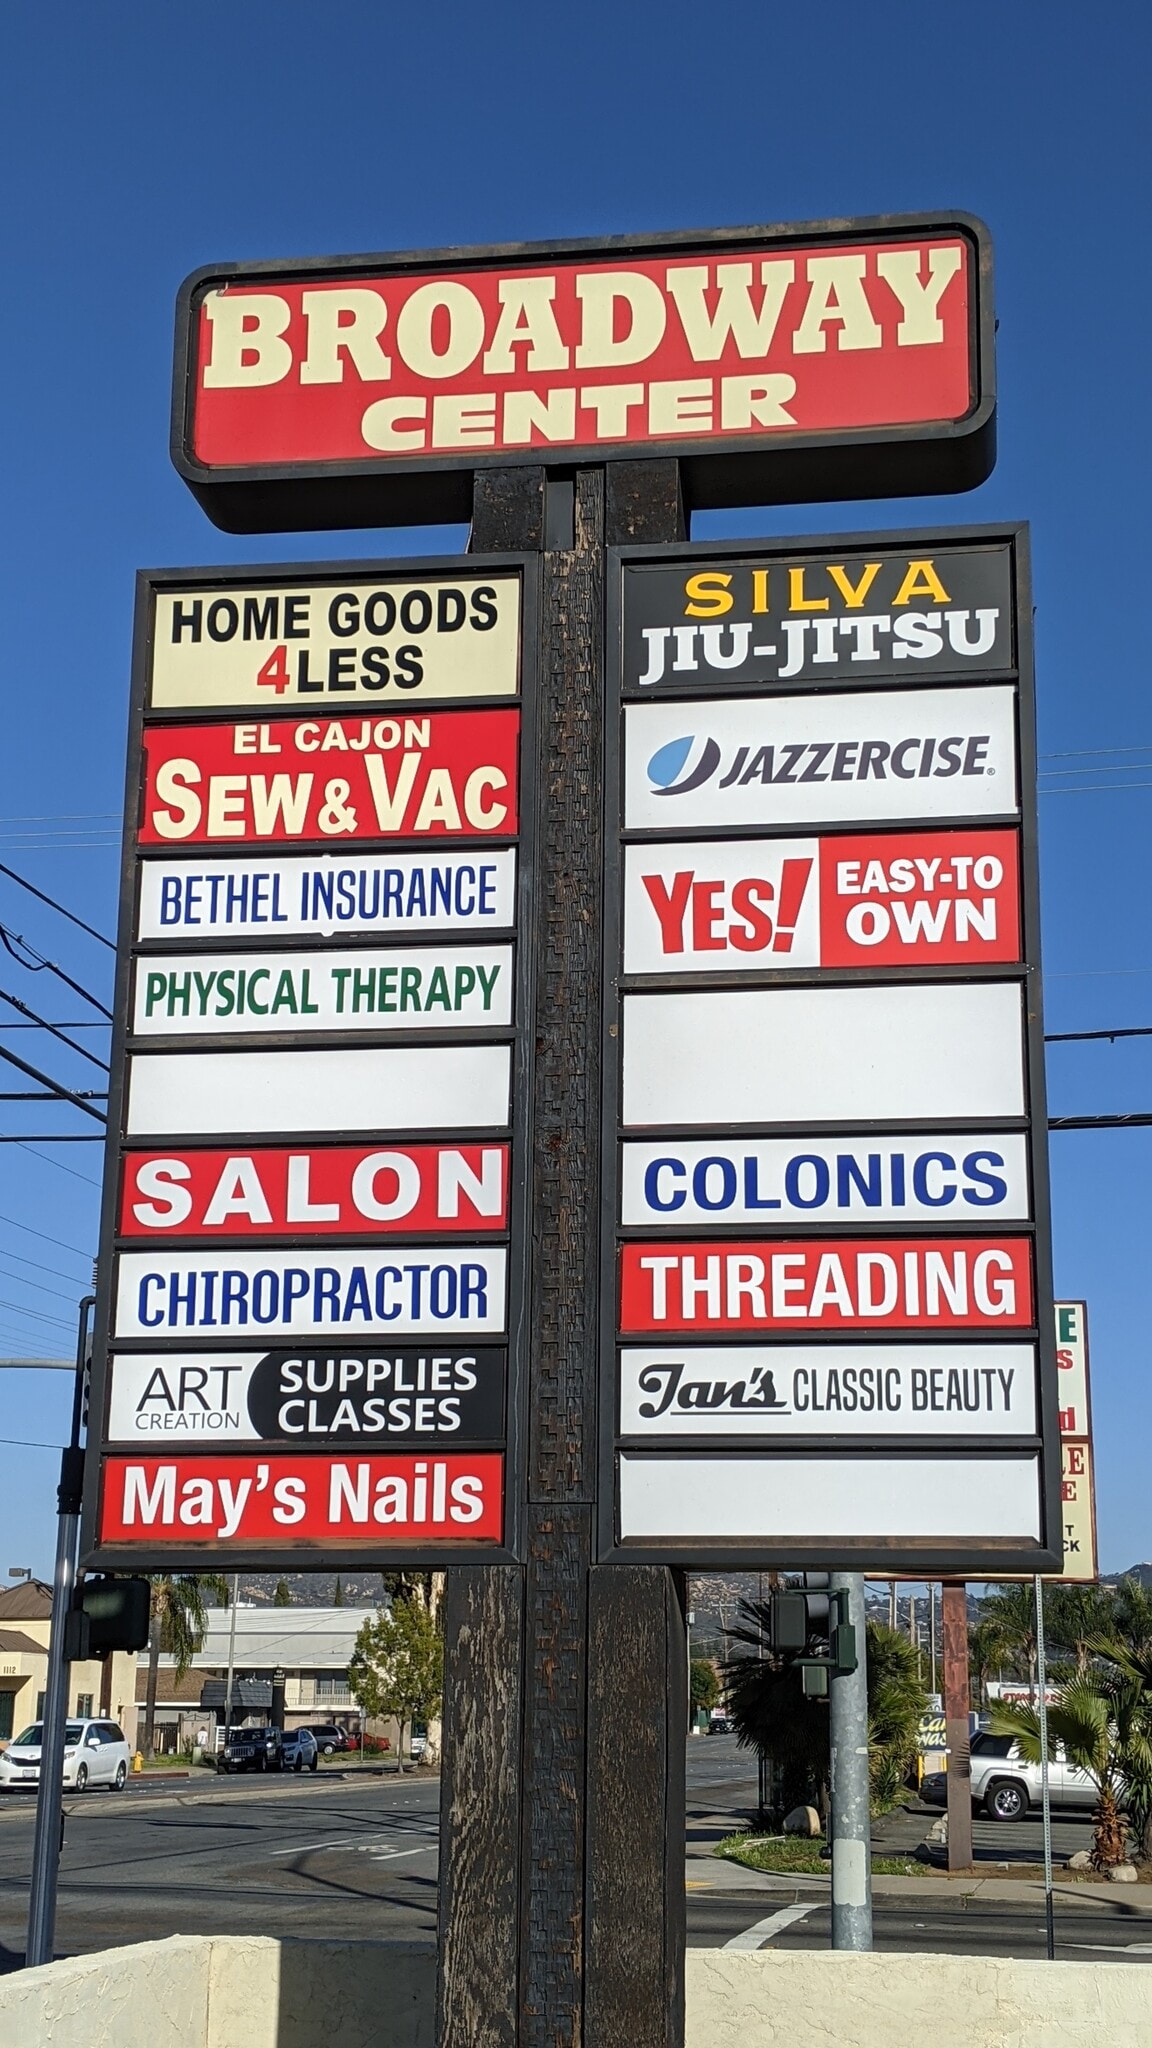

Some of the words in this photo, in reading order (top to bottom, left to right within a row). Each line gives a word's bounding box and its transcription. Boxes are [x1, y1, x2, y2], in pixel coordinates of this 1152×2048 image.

[203, 246, 962, 389] BROADWAY
[361, 373, 798, 452] CENTER
[171, 595, 311, 644] HOME
[328, 587, 498, 637] GOODS
[684, 560, 952, 618] SILVA
[639, 608, 1000, 686] JIU-JITSU
[233, 724, 282, 755] EL
[294, 719, 431, 752] CAJON
[160, 873, 288, 925] BETHEL
[301, 865, 497, 921] INSURANCE
[836, 855, 1003, 895] EASY-TO
[641, 858, 815, 954] YES!
[845, 897, 998, 946] OWN
[145, 968, 319, 1017] PHYSICAL
[331, 964, 502, 1013] THERAPY
[132, 1148, 502, 1228] SALON
[644, 1151, 1008, 1212] COLONICS
[138, 1263, 488, 1327] CHIROPRACTOR
[640, 1249, 1017, 1320] THREADING
[136, 1364, 243, 1412] ART
[279, 1357, 477, 1394] SUPPLIES
[638, 1362, 792, 1419] Jan's
[793, 1368, 901, 1411] CLASSIC
[912, 1368, 1015, 1411] BEAUTY
[135, 1411, 240, 1431] CREATION
[278, 1397, 461, 1434] CLASSES
[122, 1464, 306, 1538] May's
[328, 1462, 484, 1524] Nails
[3, 1665, 17, 1674] 1112
